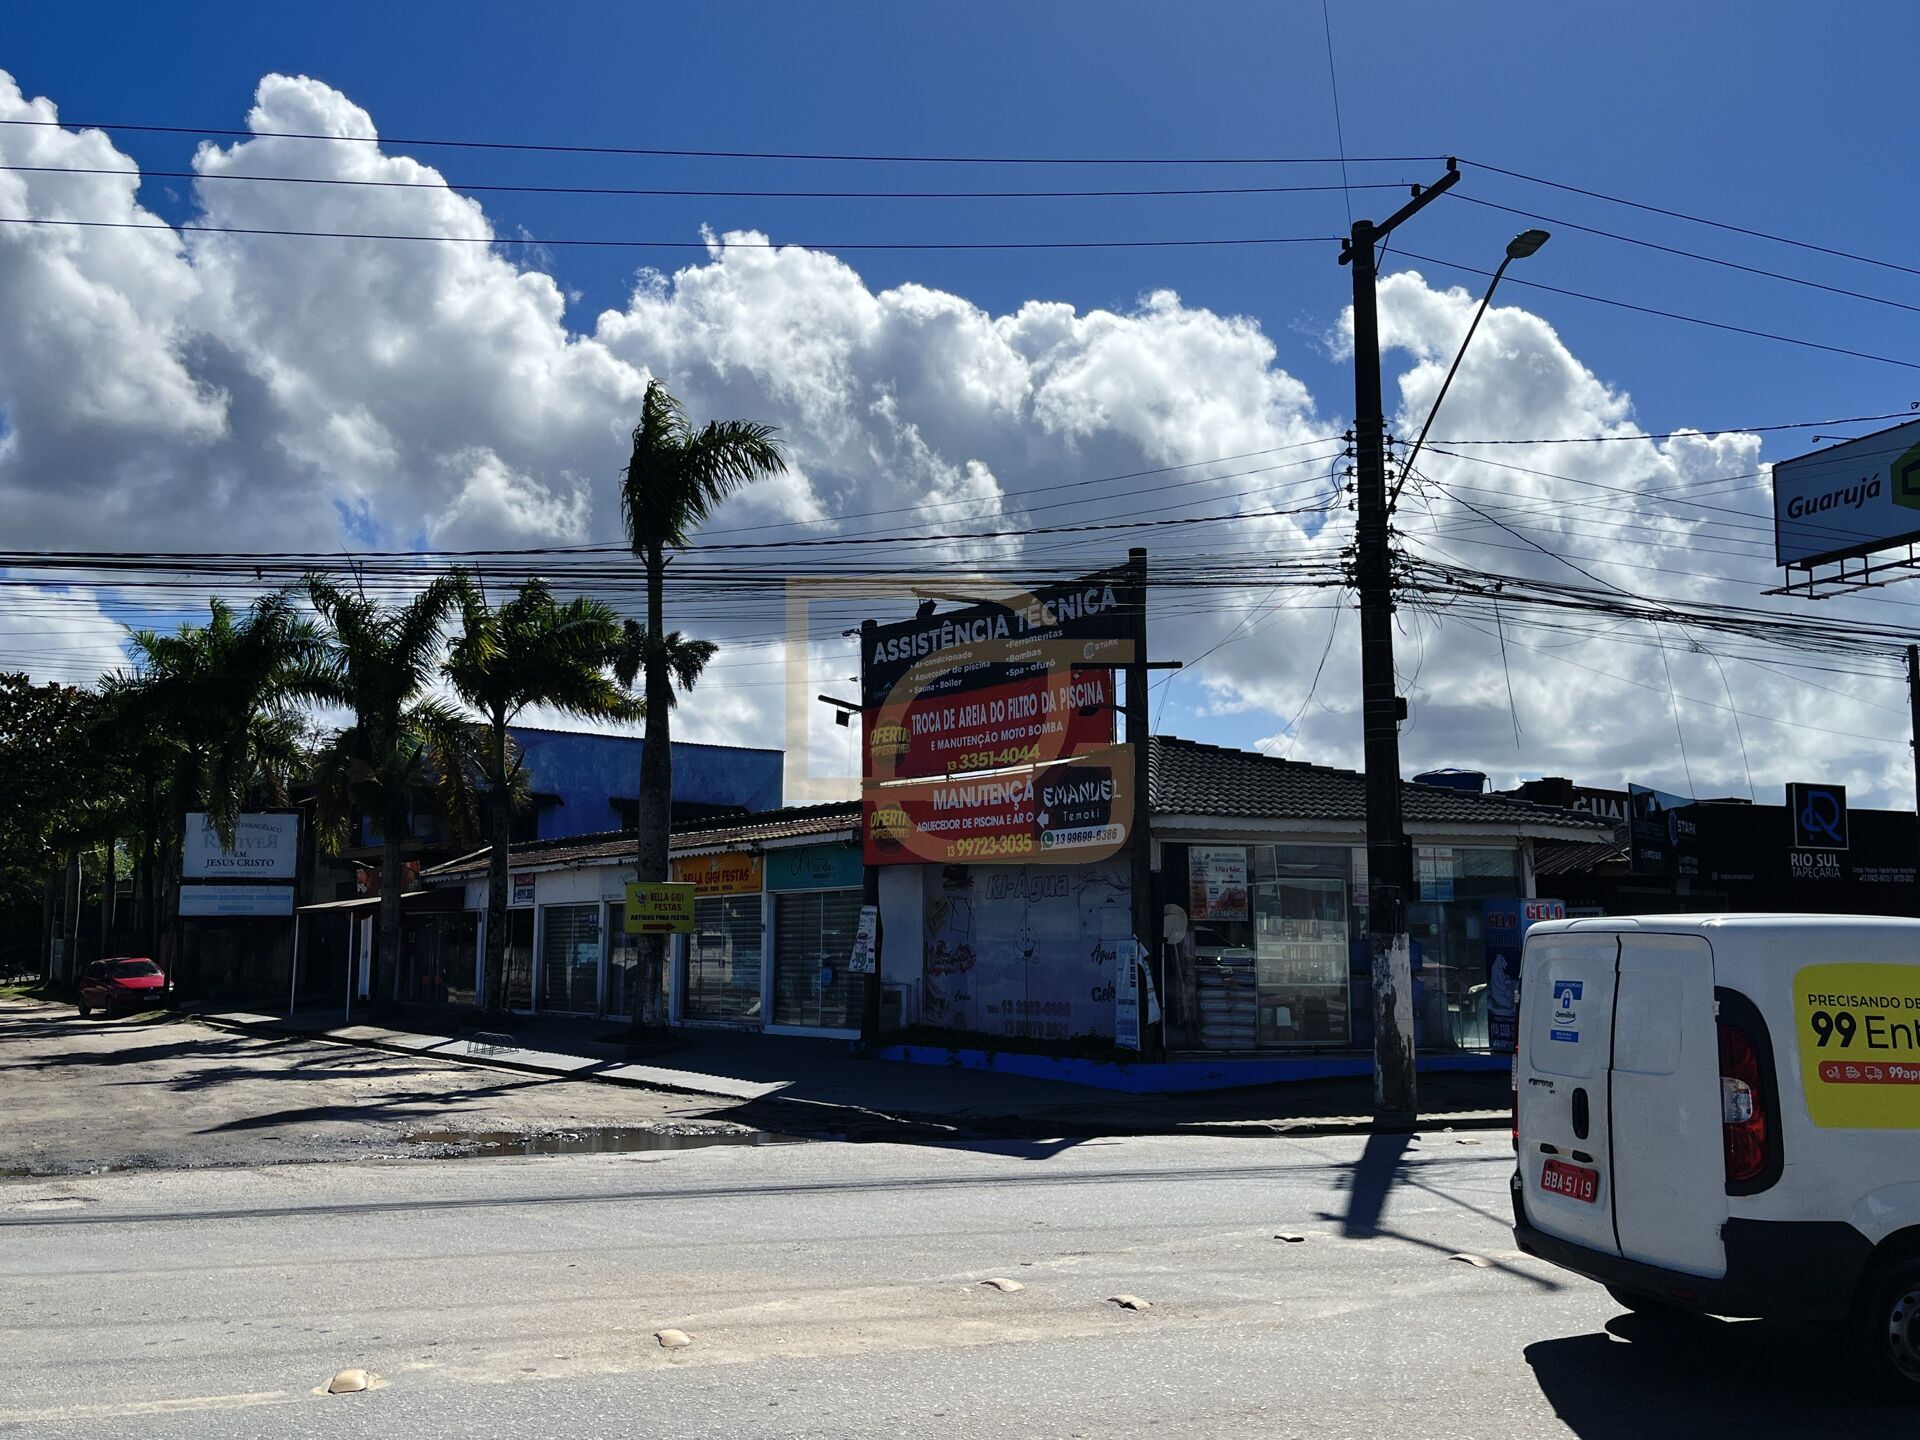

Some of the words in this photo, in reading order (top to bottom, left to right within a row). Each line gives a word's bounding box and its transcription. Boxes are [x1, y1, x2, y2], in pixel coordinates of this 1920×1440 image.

[1787, 473, 1881, 519] Guarujá
[873, 614, 1010, 665] ASSISTÊNCIA
[1014, 584, 1118, 633] TÉCNICA
[1009, 629, 1063, 648] Ferramentas
[1094, 638, 1119, 651] STARK
[915, 651, 972, 669] Ar-condicionado
[1009, 648, 1042, 662] Bombas
[914, 667, 948, 682] Aquecedor
[949, 666, 963, 676] de
[964, 661, 991, 675] piscina
[1010, 667, 1024, 678] Spa
[914, 683, 935, 693] Sauna
[911, 710, 942, 735] TROCA
[943, 708, 957, 731] DE
[958, 703, 987, 729] AREIA
[990, 699, 1005, 723] DO
[1008, 693, 1038, 721] FILTRO
[1041, 690, 1057, 713] DA
[1059, 680, 1104, 711] PISCINA
[931, 741, 936, 752] E
[937, 731, 999, 751] MANUTENÇÃO
[1001, 727, 1026, 742] MOTO
[1028, 721, 1063, 737] BOMBA
[947, 761, 958, 771] 13
[959, 743, 1040, 770] 3351-4044
[1043, 778, 1122, 807] EMANUEL
[917, 820, 961, 833] AQUECEDOR
[962, 819, 973, 829] DE
[974, 815, 1005, 828] PISCINA
[1006, 815, 1012, 824] E
[1012, 814, 1024, 824] AR
[1063, 808, 1100, 822] Temaki
[1056, 834, 1065, 844] 13
[1067, 828, 1117, 844] 99699-6386
[1677, 819, 1697, 836] STARK
[947, 846, 956, 857] 13
[957, 833, 1032, 857] 99723-3035
[205, 859, 235, 868] JESUS
[236, 858, 274, 867] CRISTO
[1790, 853, 1813, 867] RIO
[1816, 853, 1839, 867] SUL
[683, 872, 703, 885] BELLA
[705, 870, 720, 884] GIGI
[721, 868, 750, 882] FESTAS
[1791, 867, 1841, 880] TAPEÇARIA
[986, 867, 1070, 902] Ki-Água
[650, 892, 669, 902] BELLA
[671, 892, 684, 902] GIGI
[654, 903, 682, 911] FESTAS
[1526, 904, 1563, 920] GELO
[1488, 912, 1517, 929] GELO
[1091, 980, 1117, 1003] Gelo
[1808, 994, 1900, 1009] PRECISANDO
[1811, 1011, 1857, 1048] 99
[1543, 1170, 1592, 1199] BBA-5119
